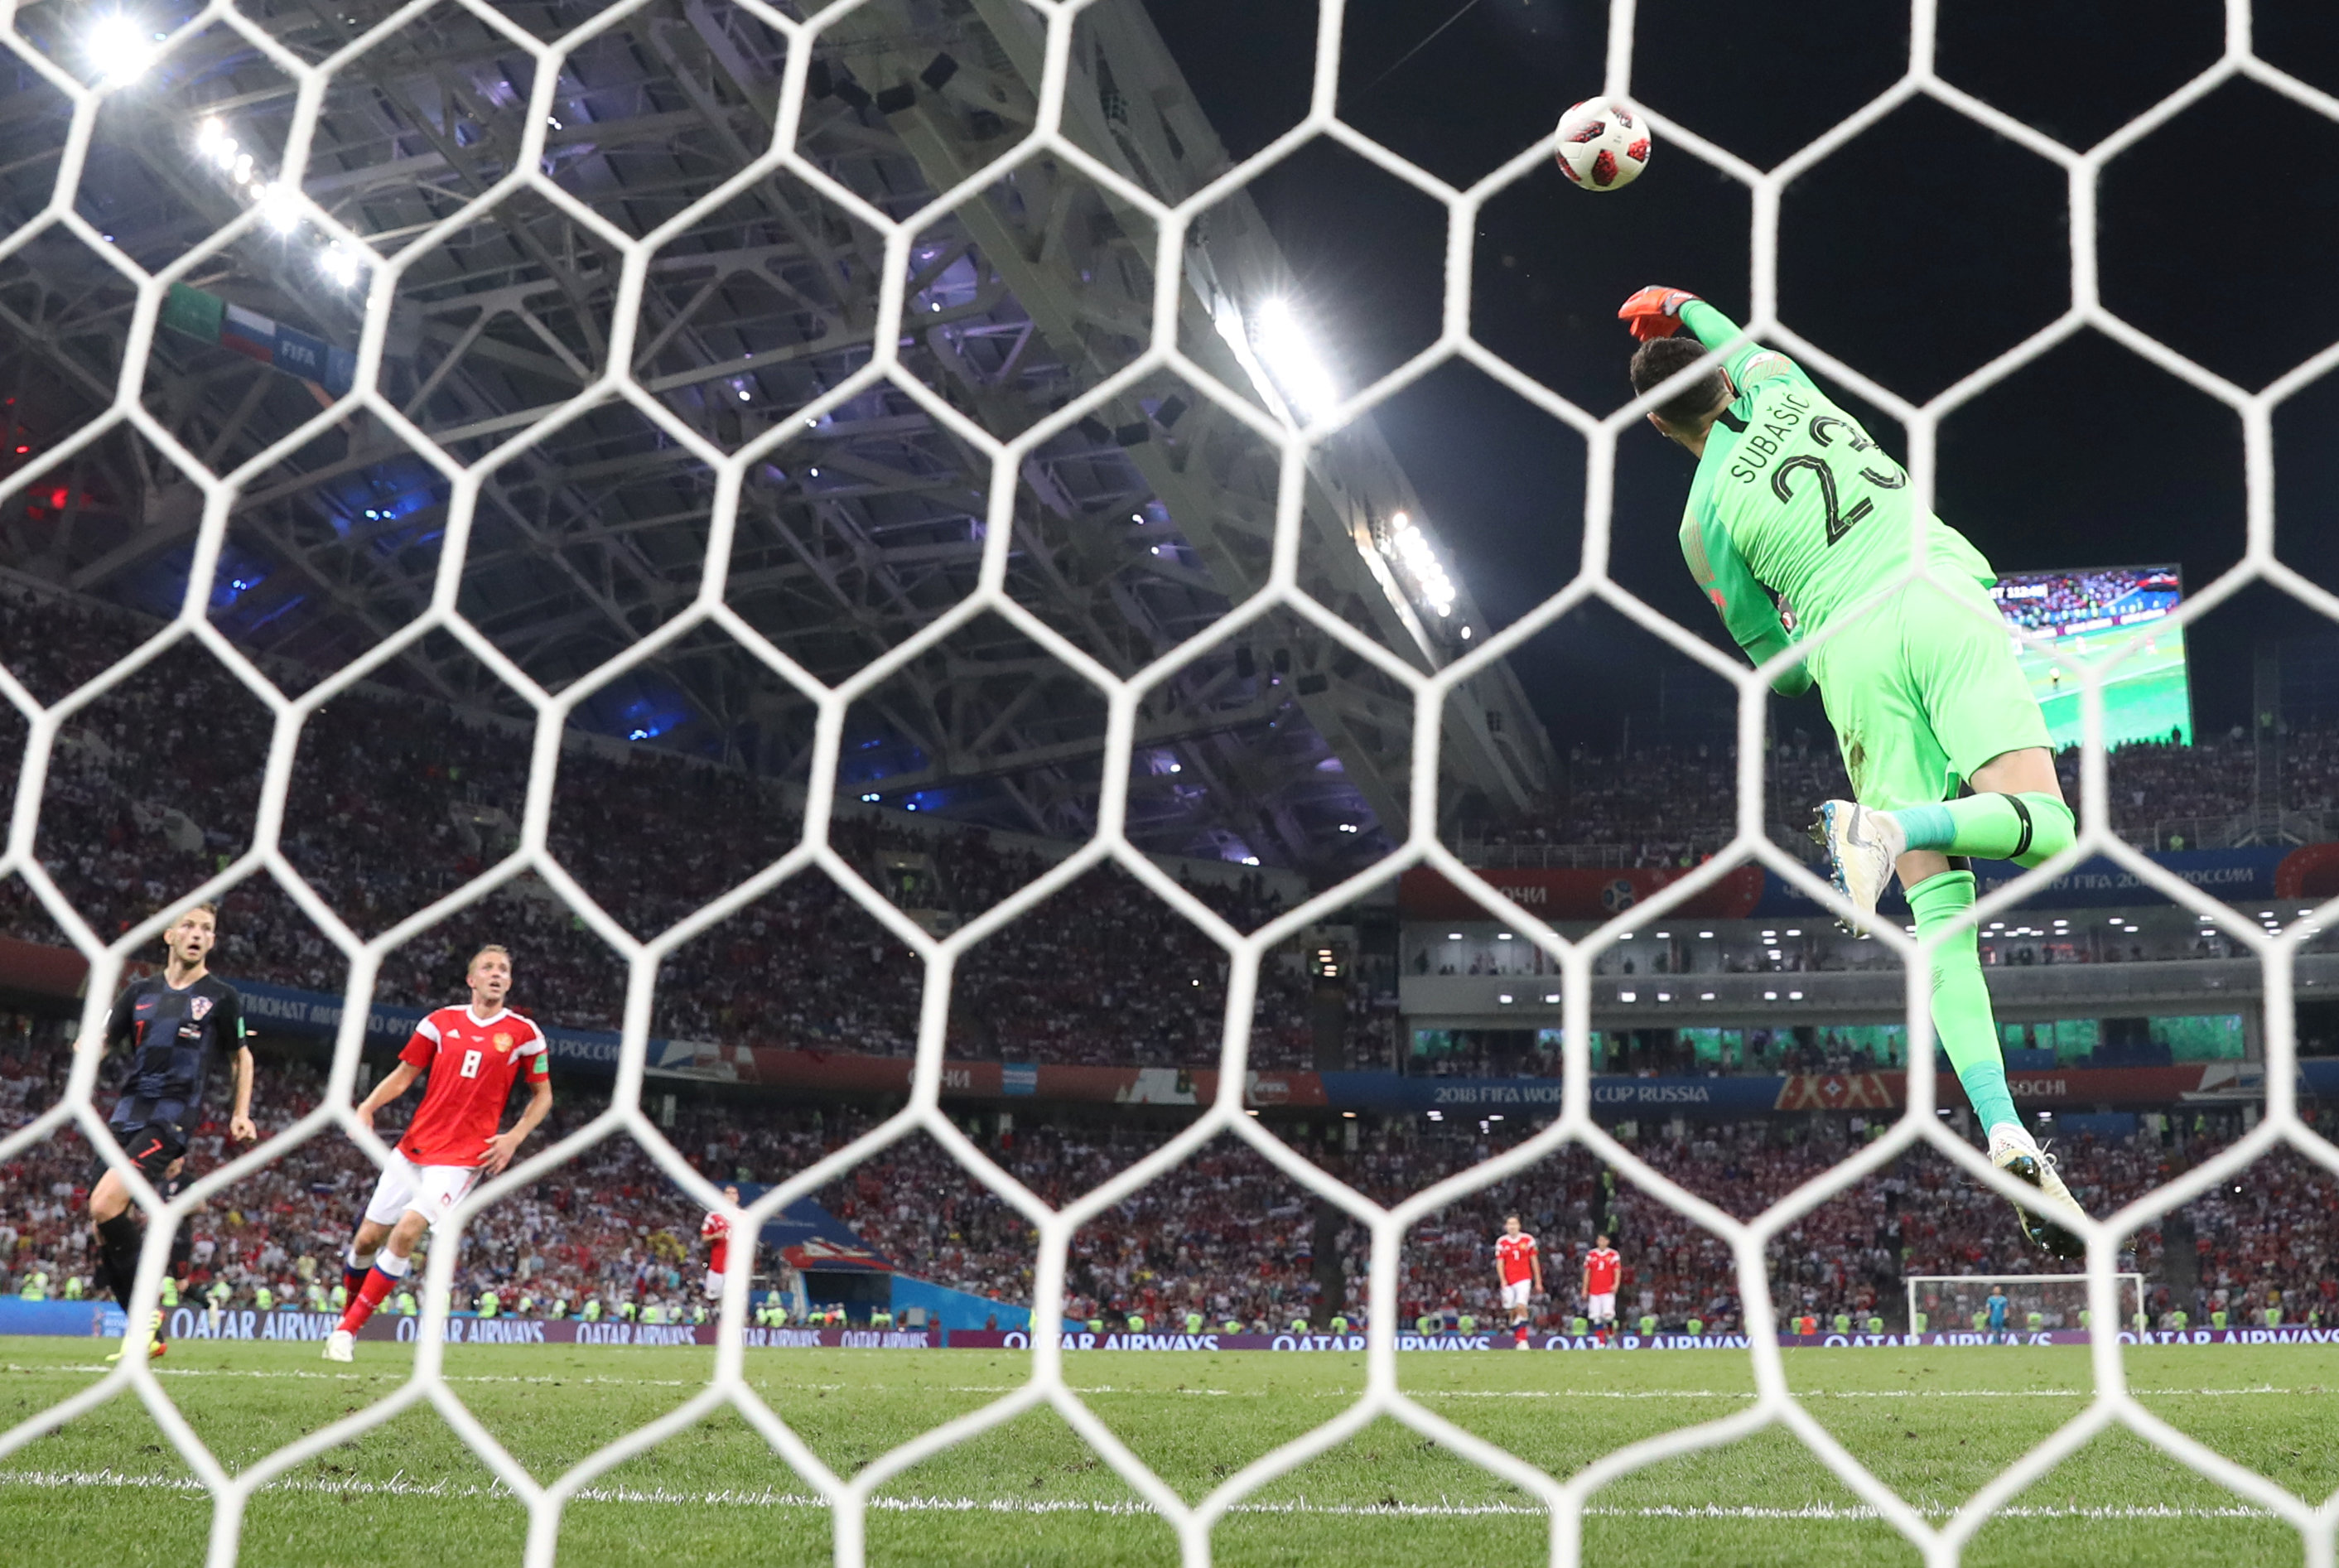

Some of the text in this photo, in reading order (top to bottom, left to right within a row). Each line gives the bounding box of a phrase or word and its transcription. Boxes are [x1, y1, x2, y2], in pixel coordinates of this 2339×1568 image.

[282, 340, 316, 365] FIFA
[1771, 416, 1906, 548] 23
[1501, 886, 1547, 904] ОЧИ
[460, 1049, 482, 1079] 8
[1435, 1086, 1709, 1102] 2018 FIFA WOR CUP RUSSIA
[138, 1138, 163, 1158] 7
[466, 1319, 545, 1344] AIRWAYS
[576, 1323, 631, 1344] QATAR
[1104, 1334, 1219, 1351] AIRWAYS
[1271, 1335, 1491, 1351] QATAR IRWAYS
[1650, 1336, 1755, 1350] AIRWAY
